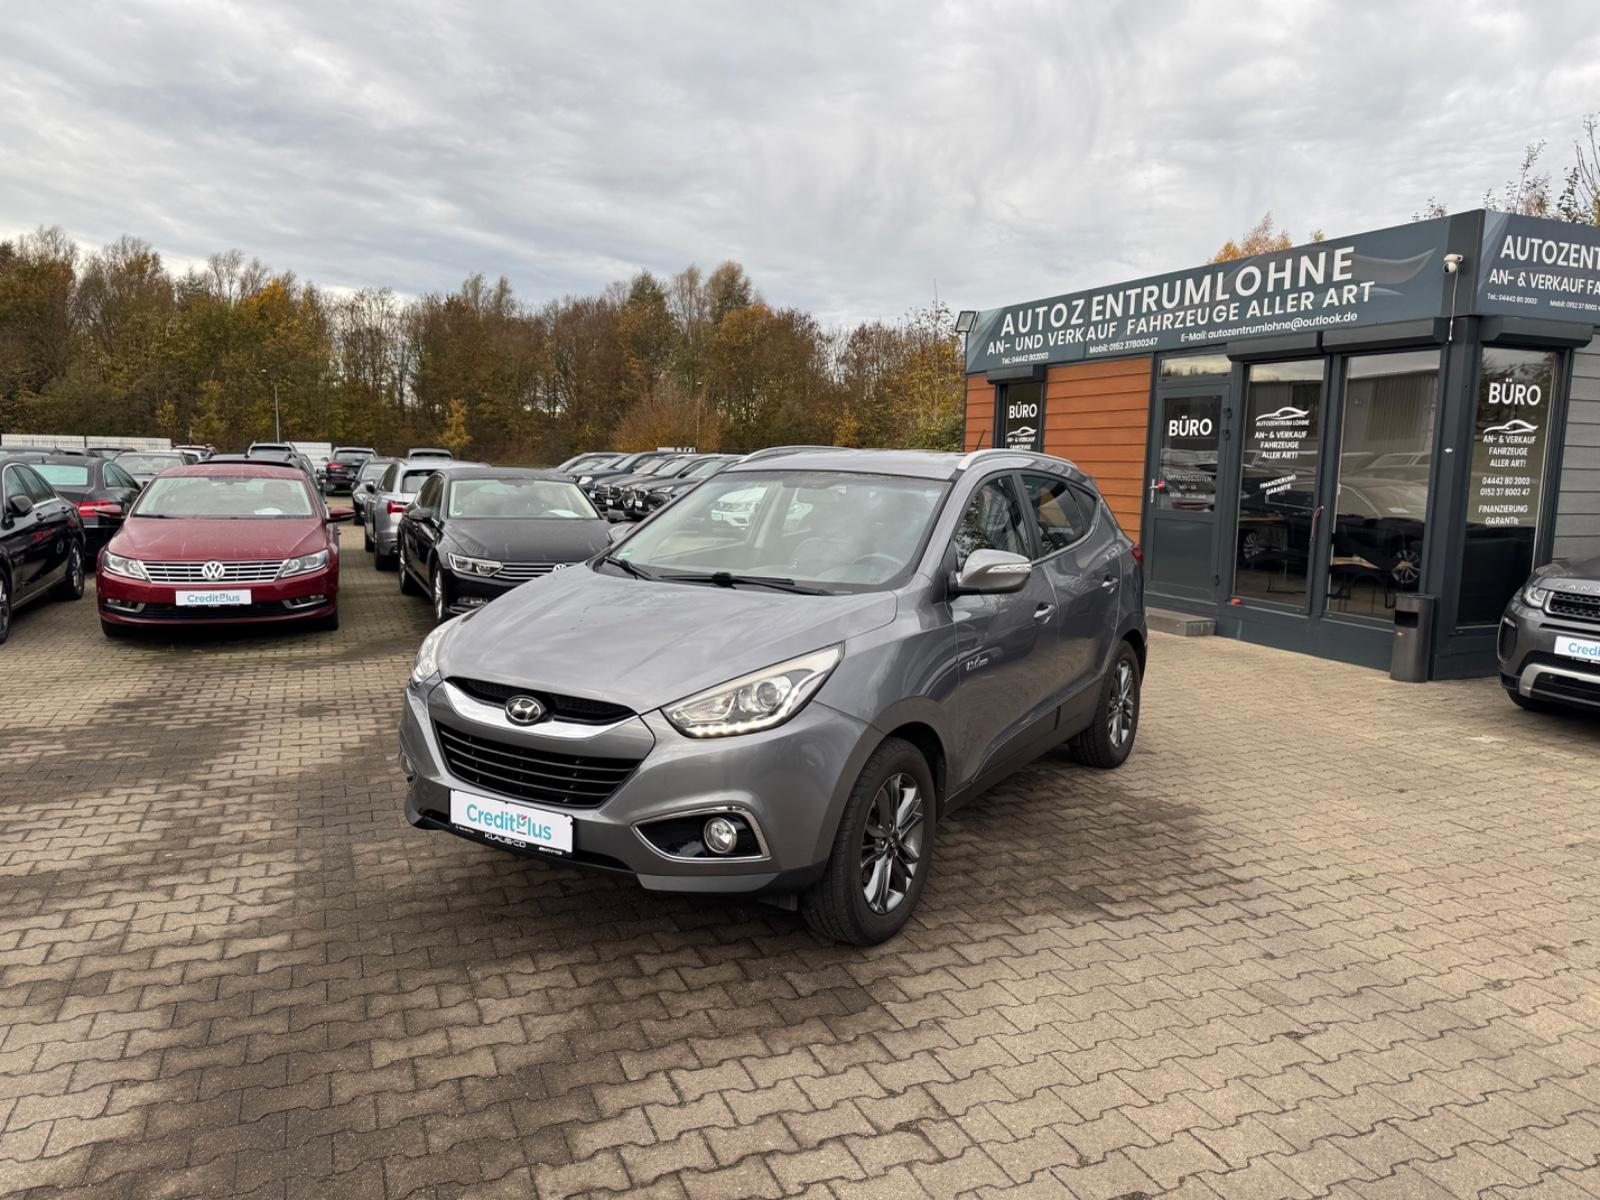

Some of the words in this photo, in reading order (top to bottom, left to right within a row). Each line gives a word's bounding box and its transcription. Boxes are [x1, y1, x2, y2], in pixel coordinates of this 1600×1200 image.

[1489, 268, 1514, 285] AN-
[1517, 272, 1526, 287] &
[1529, 273, 1585, 293] VERKAUF
[986, 341, 1011, 356] AN-
[1015, 332, 1044, 351] UND
[1047, 322, 1118, 347] VERKAUF
[1126, 302, 1240, 336] FAHRZEUGE
[1246, 290, 1314, 319] ALLER
[1322, 281, 1376, 306] ART
[1208, 312, 1358, 339] autozentrumlohne@outlook.de
[1488, 378, 1542, 406] BÜRO
[1009, 401, 1038, 419] BÜRO
[1168, 416, 1213, 437] BÜRO
[1269, 431, 1275, 439] &
[1276, 430, 1308, 439] VERKAUF
[1483, 434, 1497, 443] AN-
[1499, 435, 1504, 444] &
[1505, 435, 1536, 445] VERKAUF
[1260, 440, 1299, 449] FAHRZEUGE
[1262, 451, 1281, 459] ALLER
[1488, 446, 1528, 456] FAHRZEUGE
[1489, 459, 1510, 467] ALLER
[1510, 459, 1527, 468] ART!
[1481, 476, 1503, 485] 04442
[1504, 476, 1513, 485] 80
[1514, 476, 1530, 485] 2003
[1480, 487, 1495, 496] 0152
[1496, 487, 1504, 496] 37
[1504, 487, 1521, 496] 8002
[1522, 487, 1530, 496] 47
[1479, 504, 1528, 513] FINANZIERUNG
[187, 593, 241, 603] CreditPlus
[466, 804, 552, 841] CreditPlus
